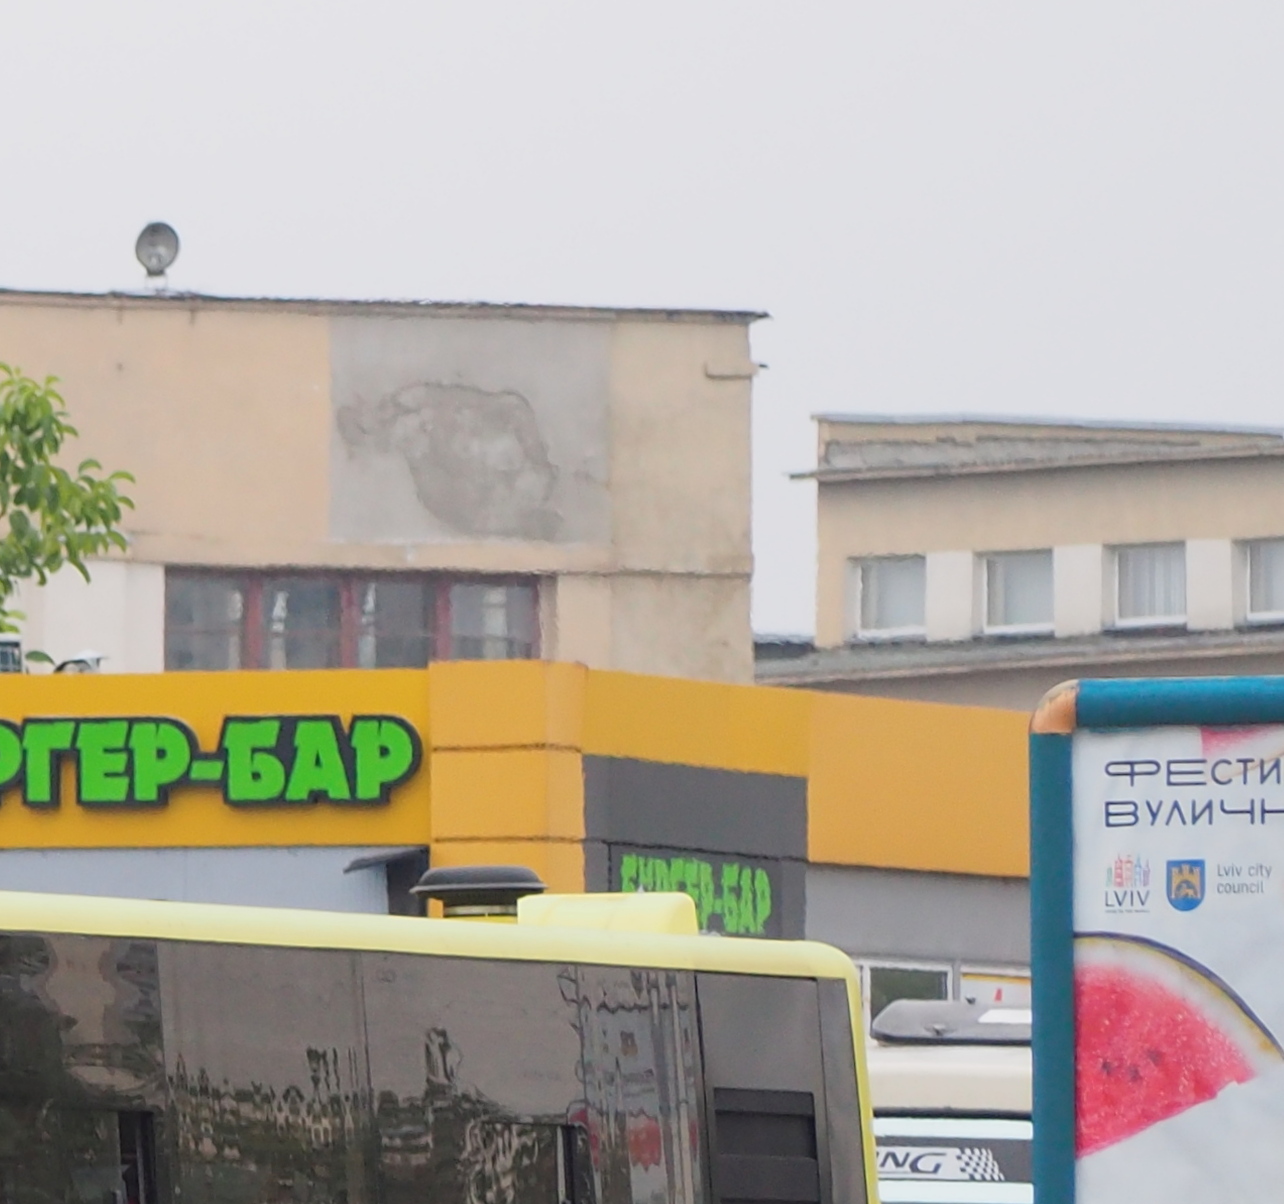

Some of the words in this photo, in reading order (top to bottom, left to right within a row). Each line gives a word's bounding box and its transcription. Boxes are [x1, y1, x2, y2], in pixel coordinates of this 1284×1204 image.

[1104, 757, 1282, 788] ФЕСТИ
[1217, 863, 1243, 878] Lviv
[1248, 862, 1273, 879] city
[1216, 880, 1265, 895] council
[1104, 889, 1150, 908] LVIV
[876, 1151, 947, 1175] NG
